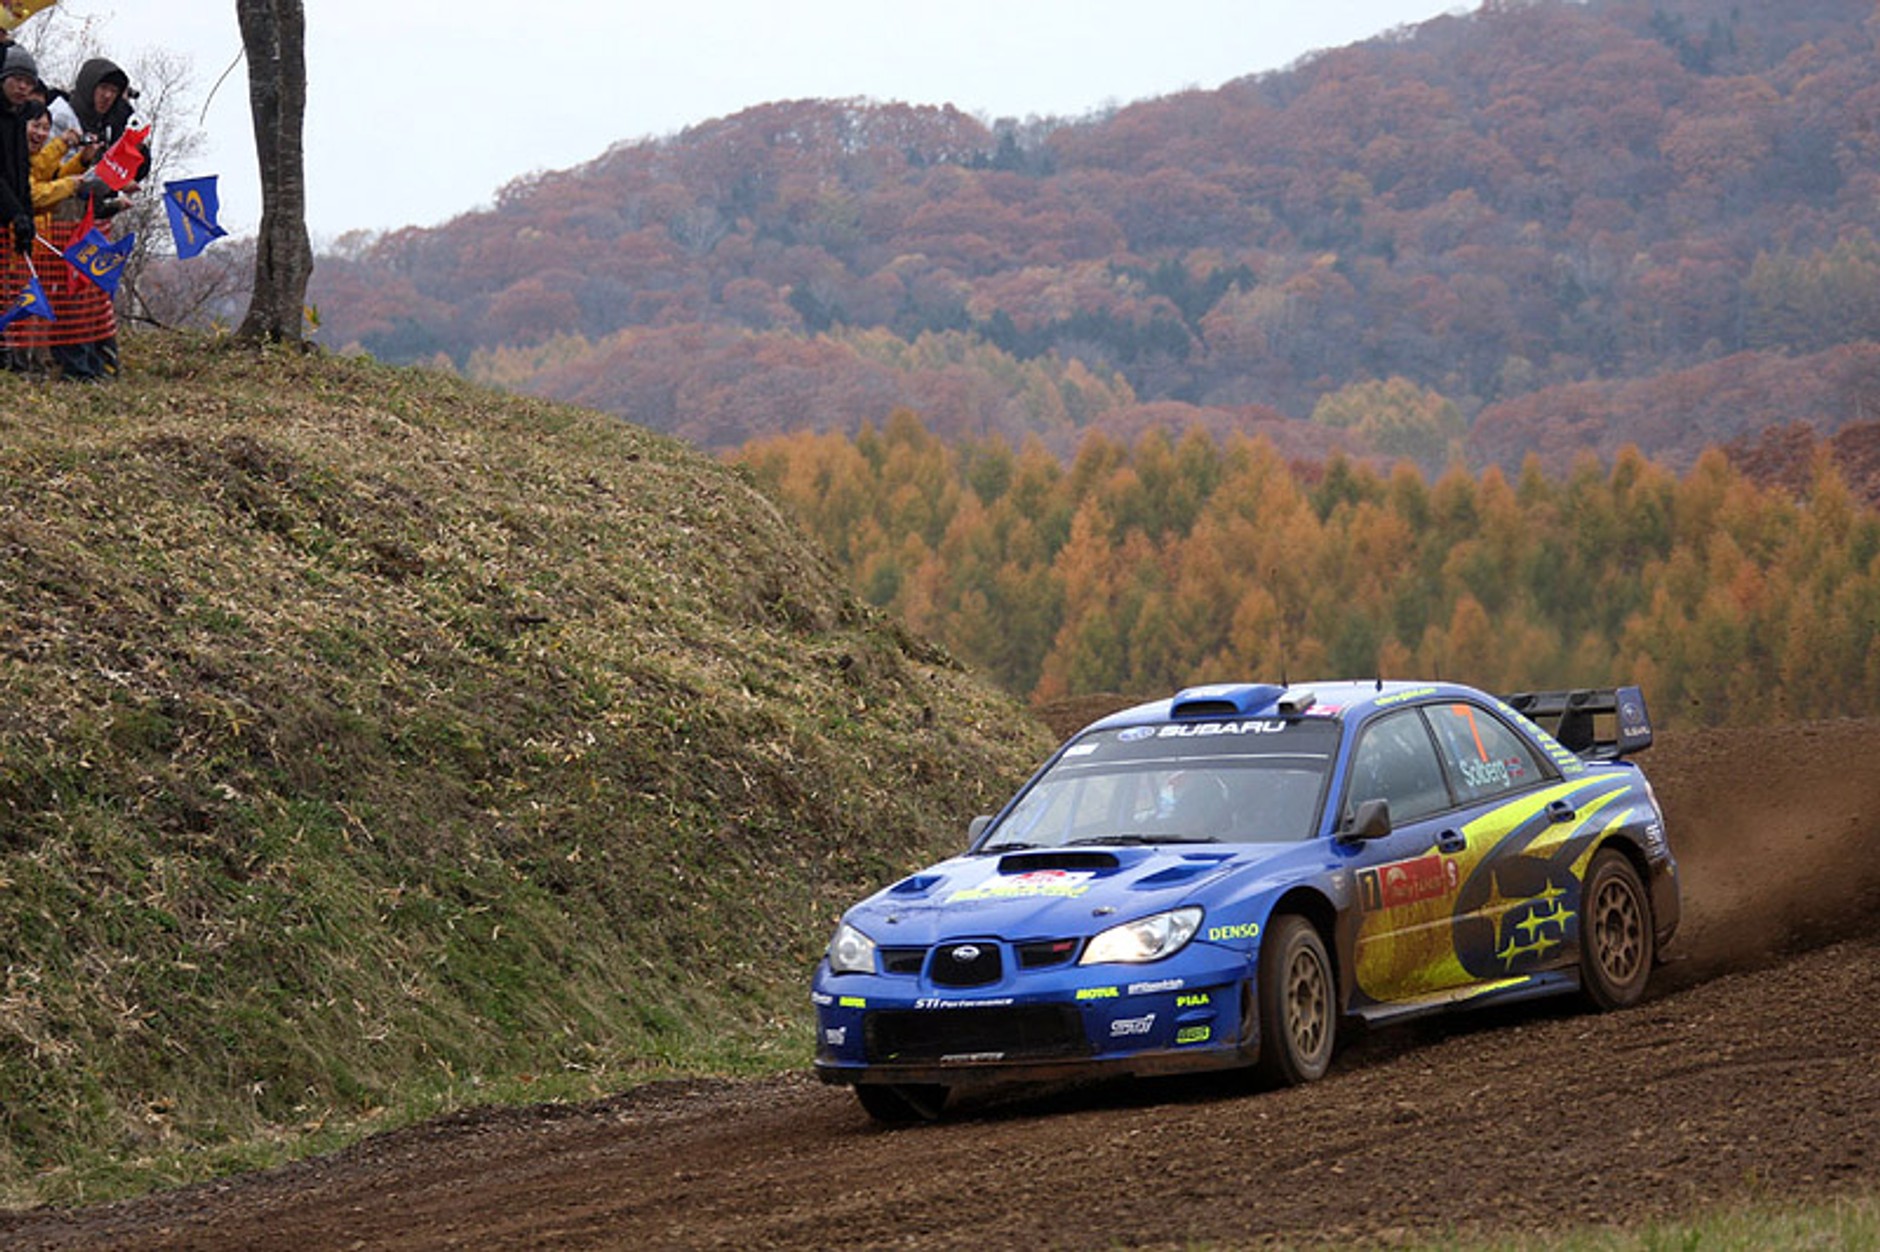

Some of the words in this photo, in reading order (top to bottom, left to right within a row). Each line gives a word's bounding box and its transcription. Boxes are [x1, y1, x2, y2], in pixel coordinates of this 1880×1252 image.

[1158, 720, 1286, 738] SUBARU
[1451, 702, 1489, 763] 7
[1209, 923, 1260, 941] DENSO
[1076, 986, 1119, 1000] MOTUL
[1176, 993, 1210, 1007] PIAA
